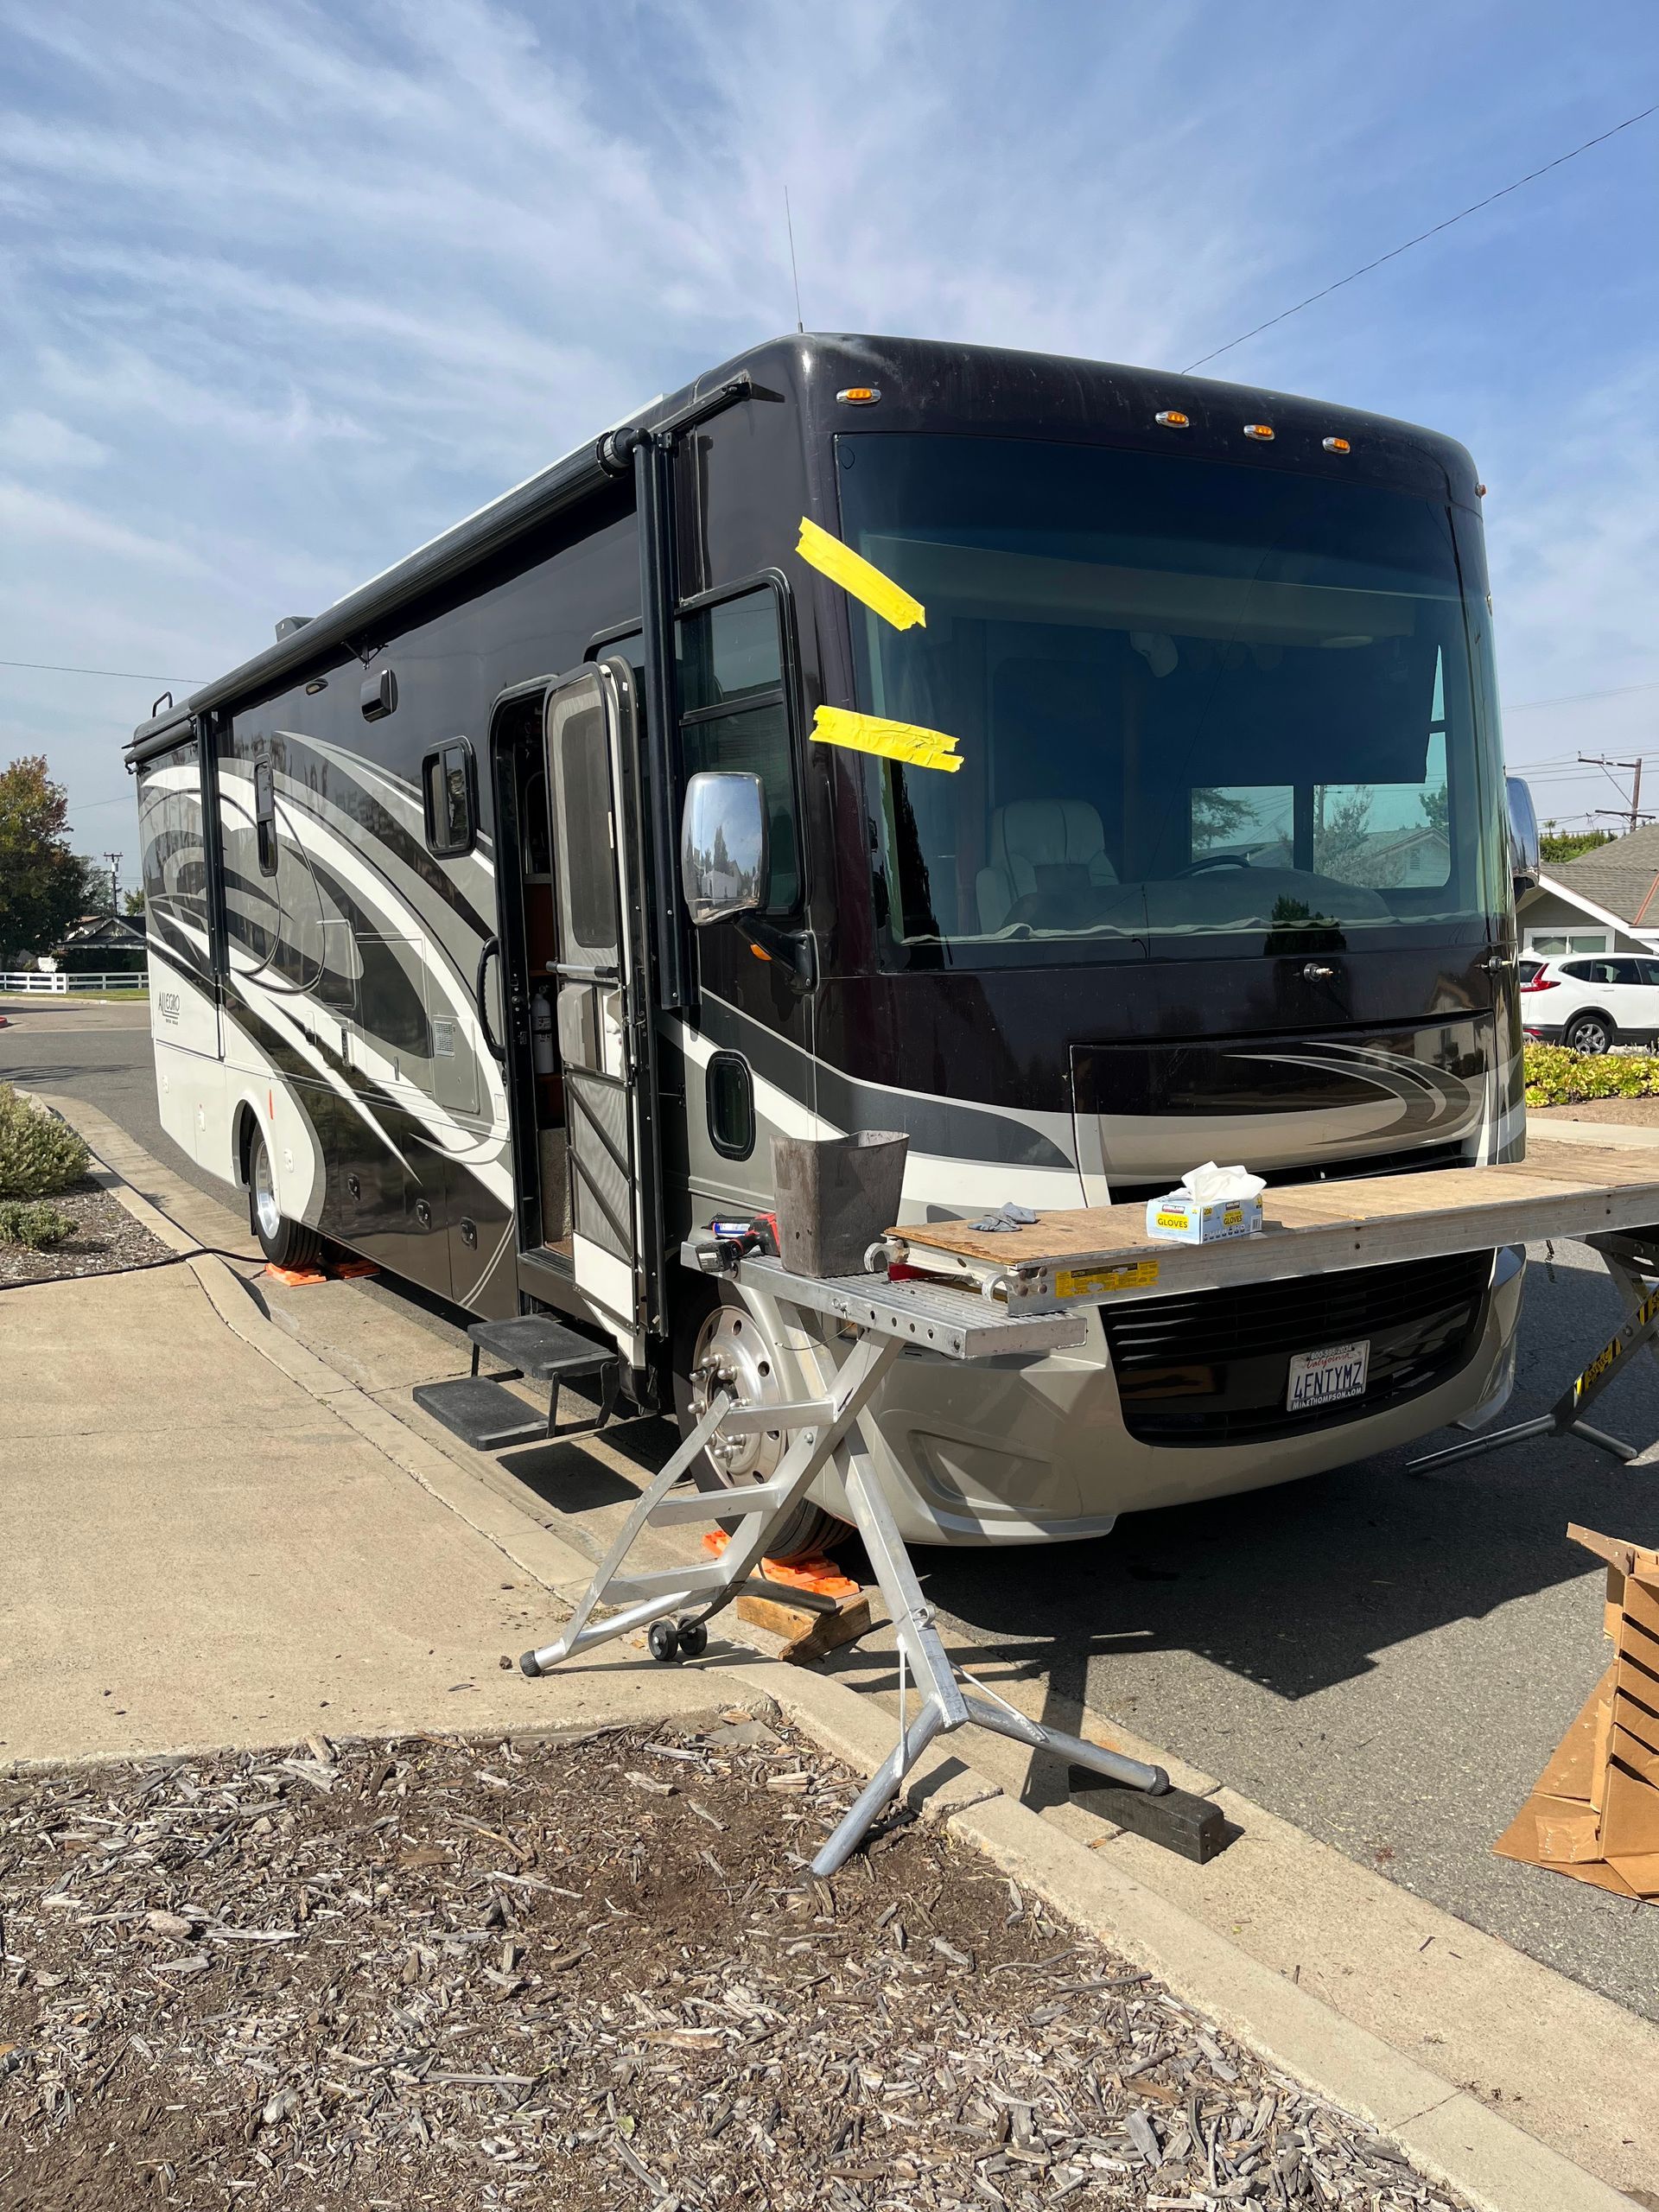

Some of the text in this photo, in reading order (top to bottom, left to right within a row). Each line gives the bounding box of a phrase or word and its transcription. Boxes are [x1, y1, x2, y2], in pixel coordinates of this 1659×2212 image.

[158, 991, 181, 1014] ALLEGRO
[1157, 1217, 1188, 1229] GLOVES
[1224, 1215, 1243, 1225] GLOVES
[1306, 1353, 1354, 1369] California
[1294, 1361, 1363, 1399] 4FNTYMZ
